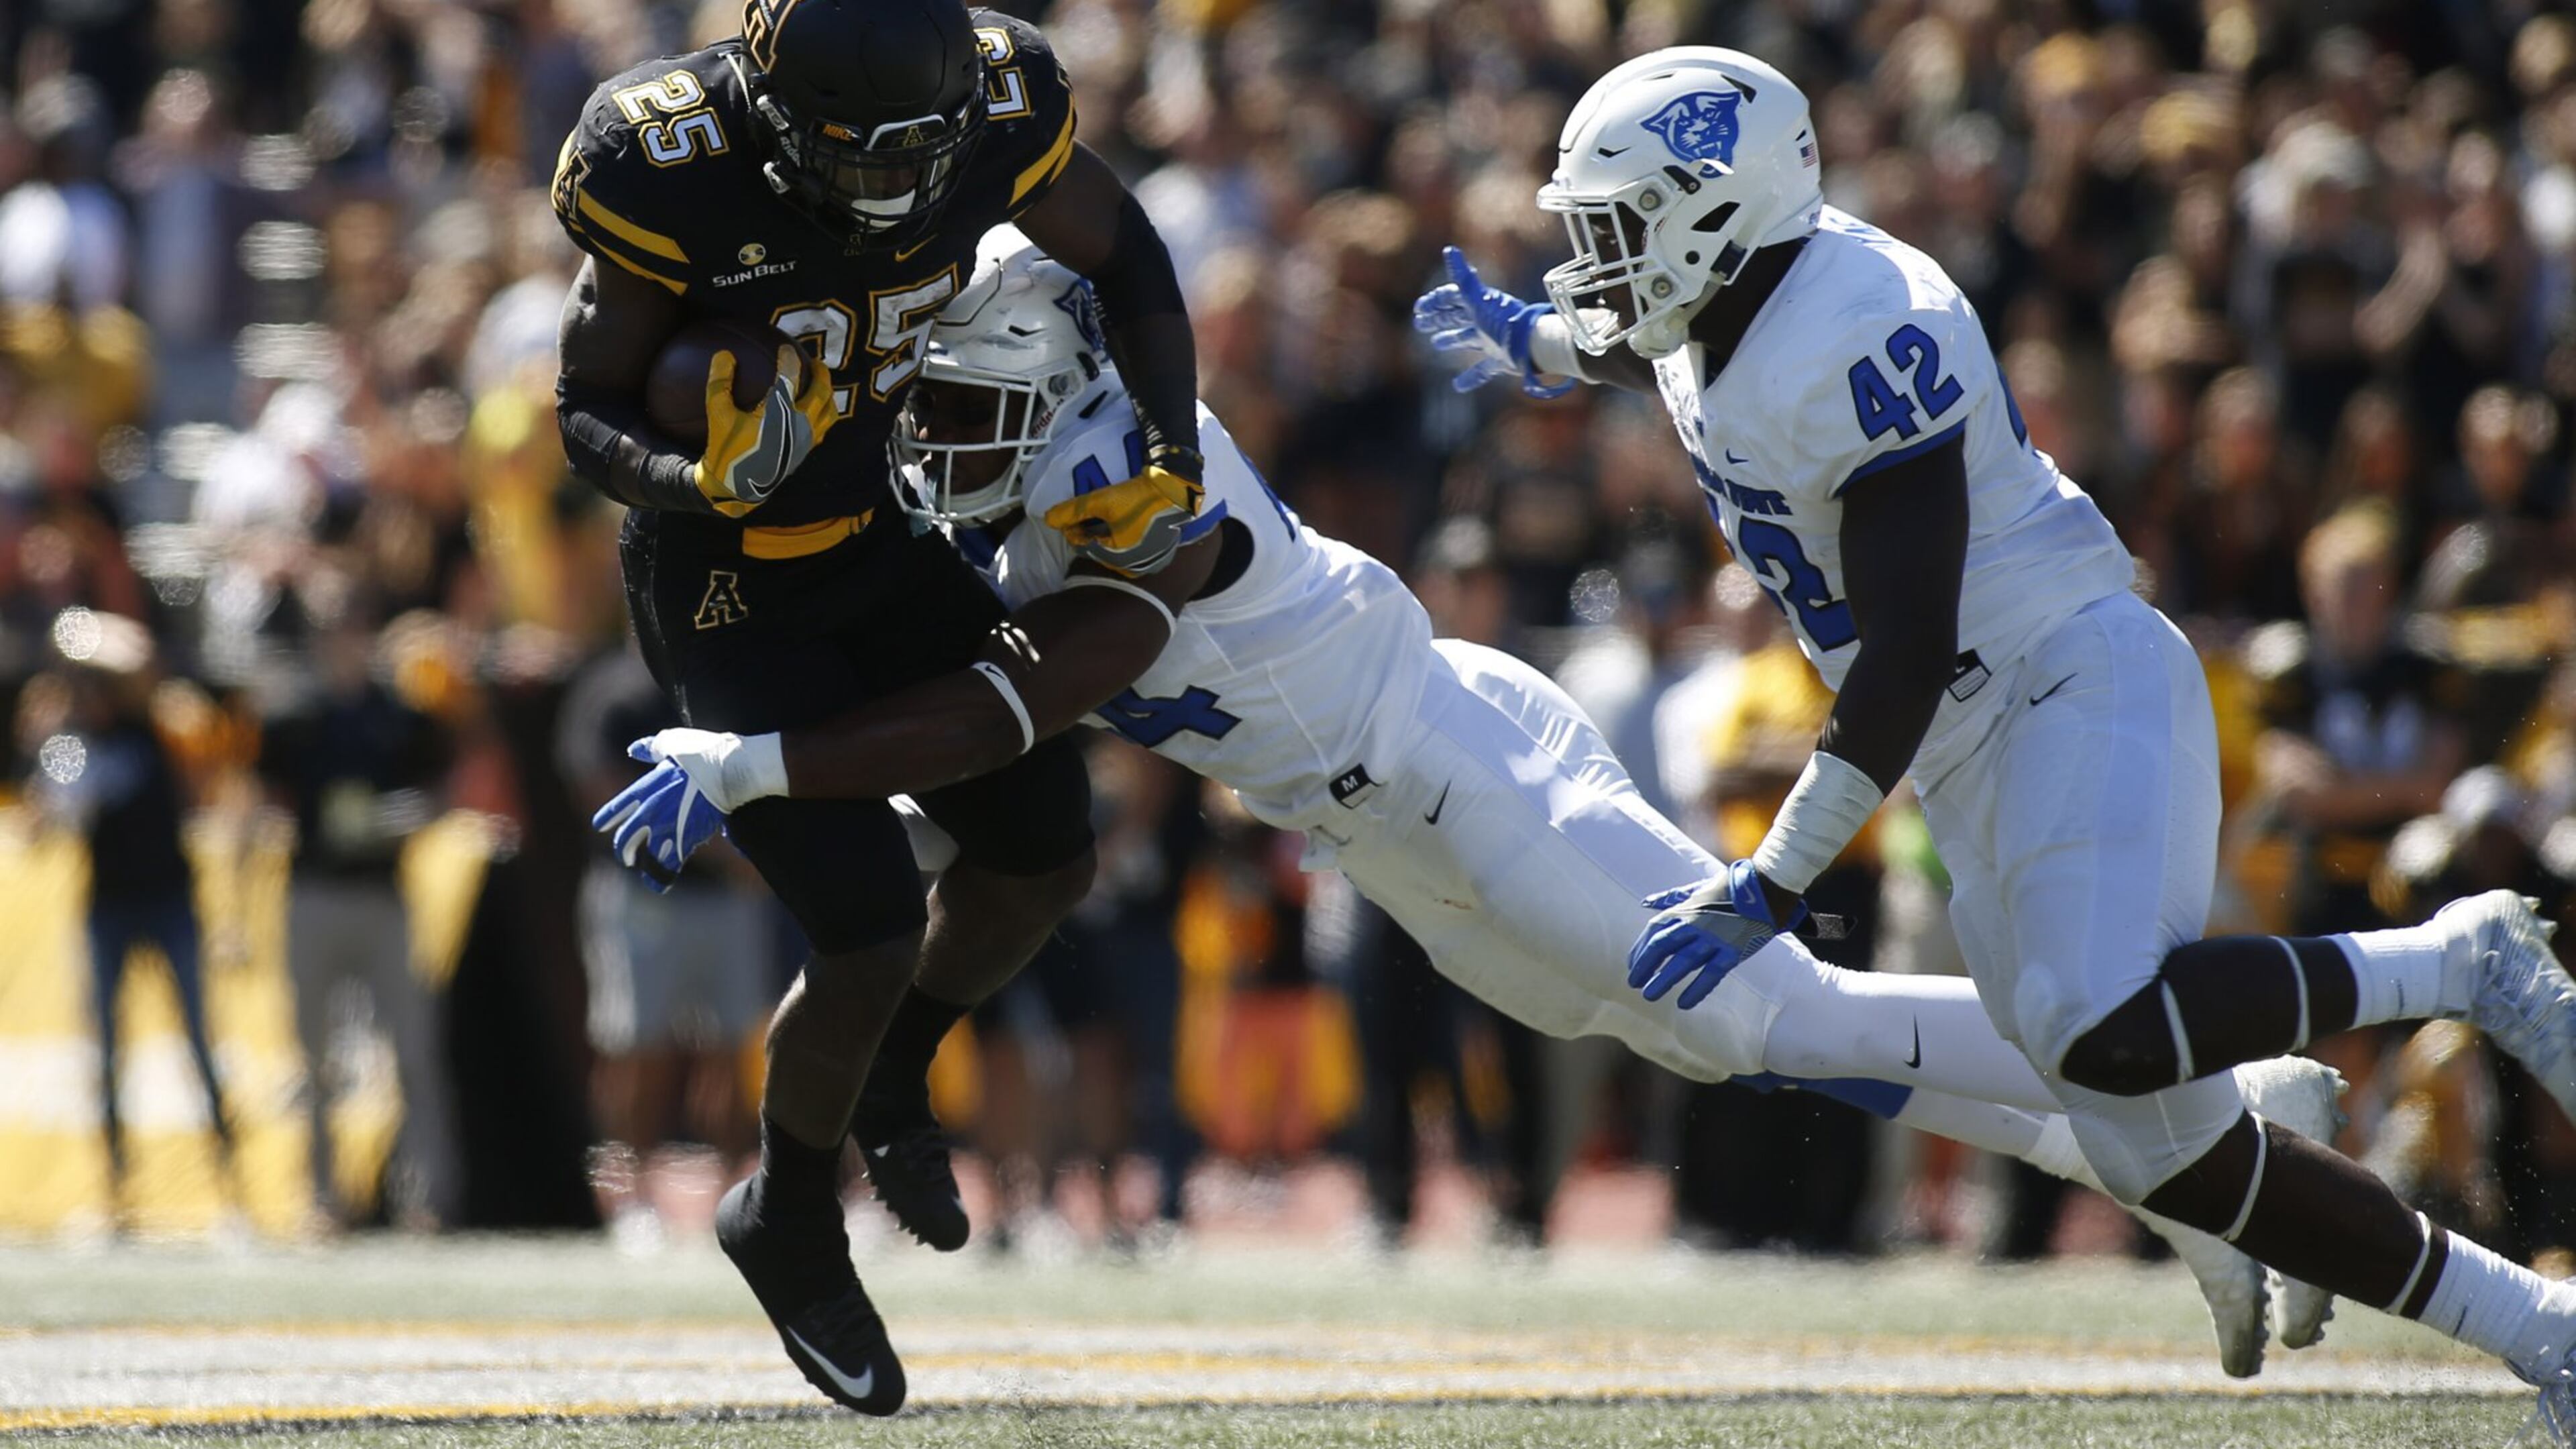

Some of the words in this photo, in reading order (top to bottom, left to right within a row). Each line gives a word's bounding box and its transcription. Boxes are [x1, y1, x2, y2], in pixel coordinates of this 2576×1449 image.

[611, 69, 731, 168] 25
[712, 270, 752, 287] SUN
[755, 260, 796, 278] BELT
[1847, 324, 1965, 442] 42
[695, 570, 748, 630] A
[1705, 490, 1860, 652] 2
